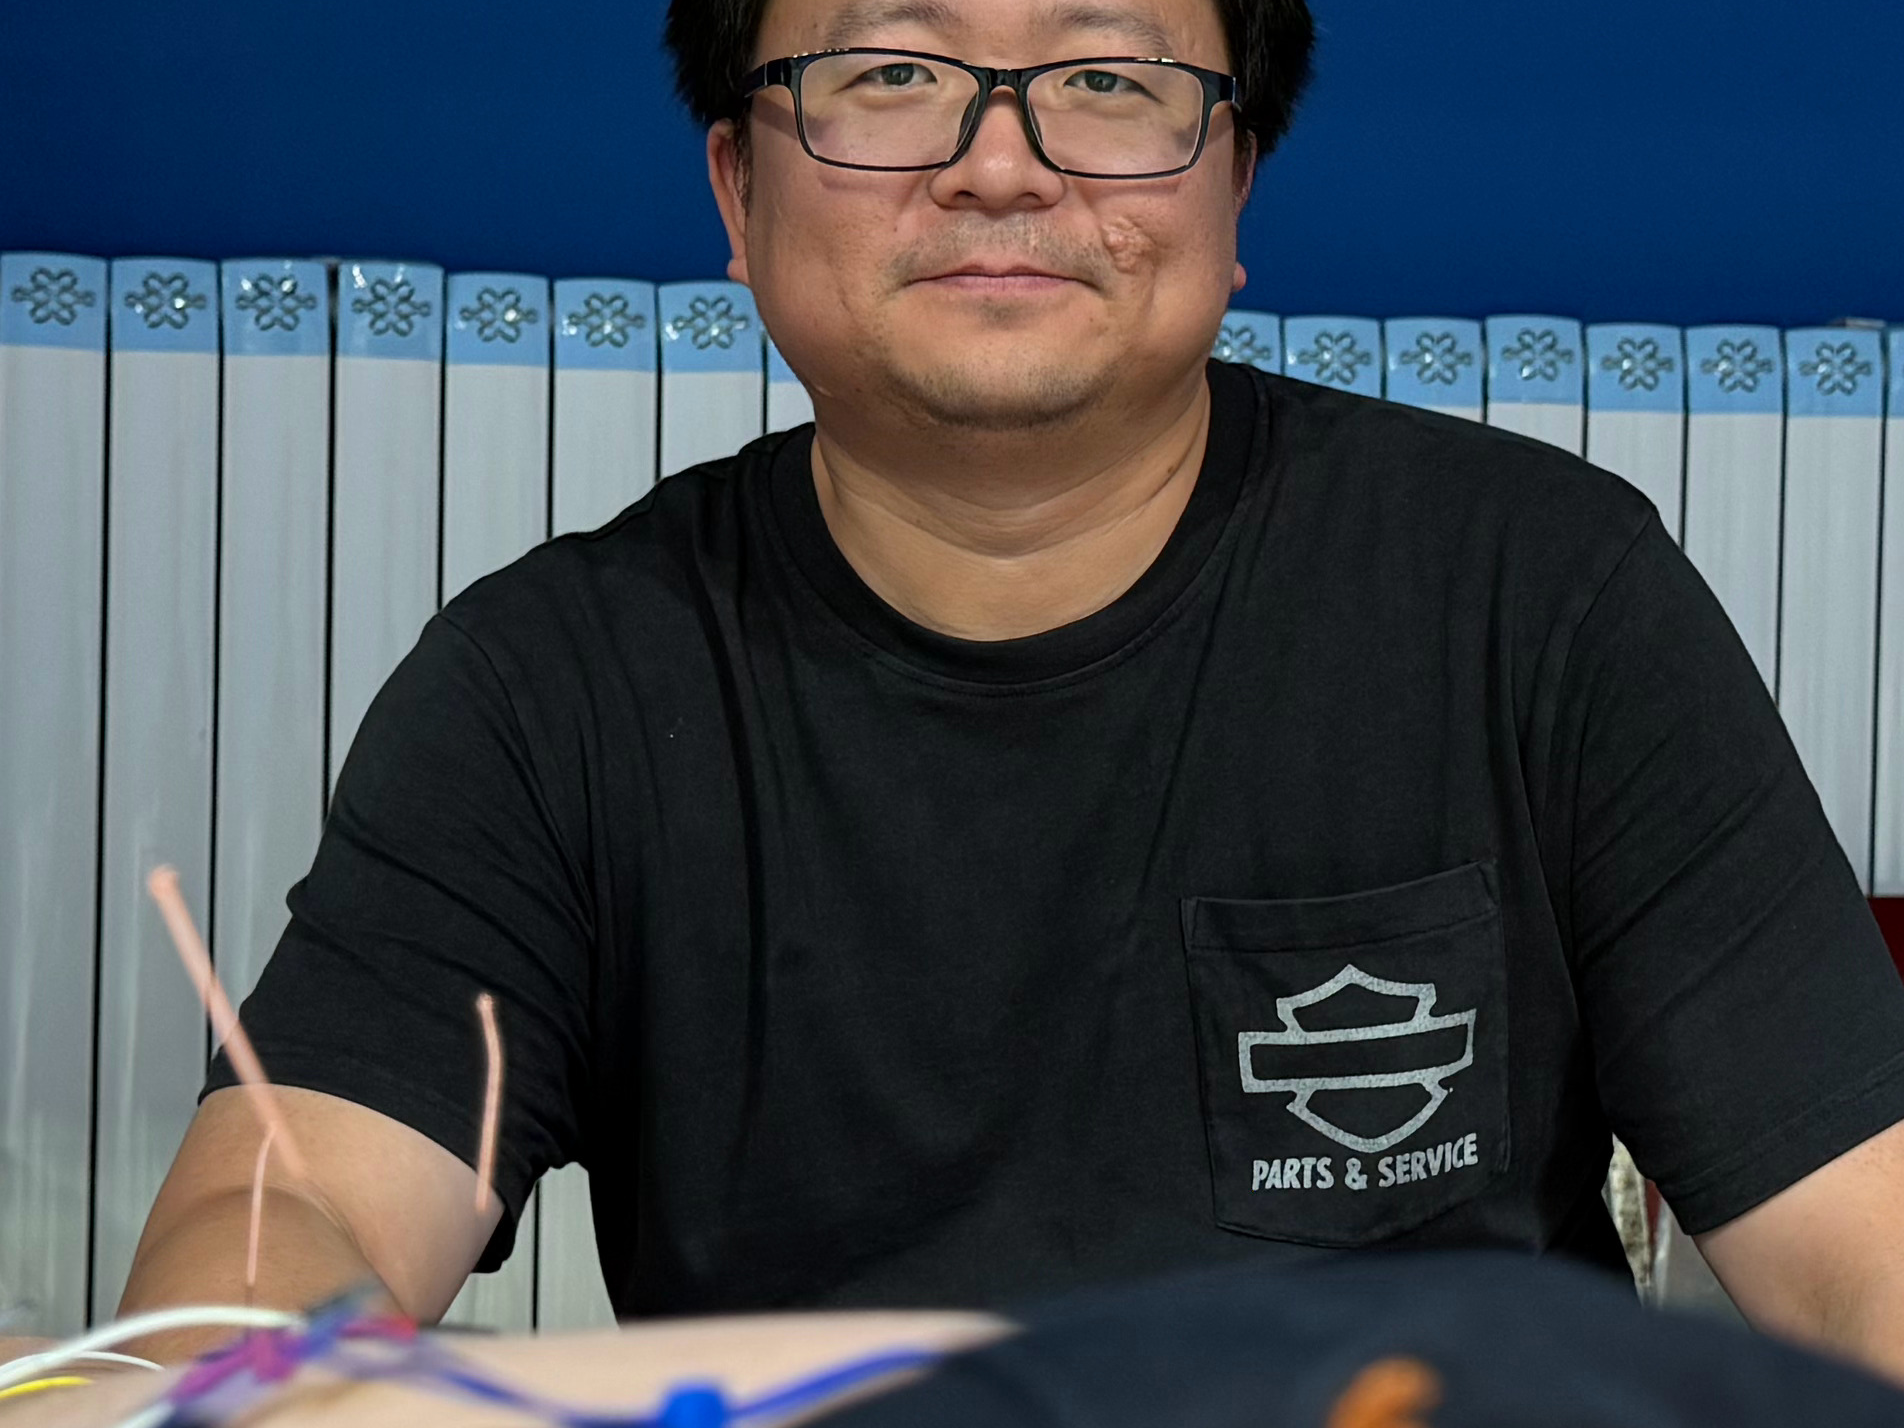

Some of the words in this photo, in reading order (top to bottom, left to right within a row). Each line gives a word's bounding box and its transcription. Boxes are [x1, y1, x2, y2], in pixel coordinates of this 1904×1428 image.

[1251, 1156, 1333, 1191] PARTS
[1344, 1159, 1369, 1191] &
[1378, 1132, 1479, 1188] SERVICE
